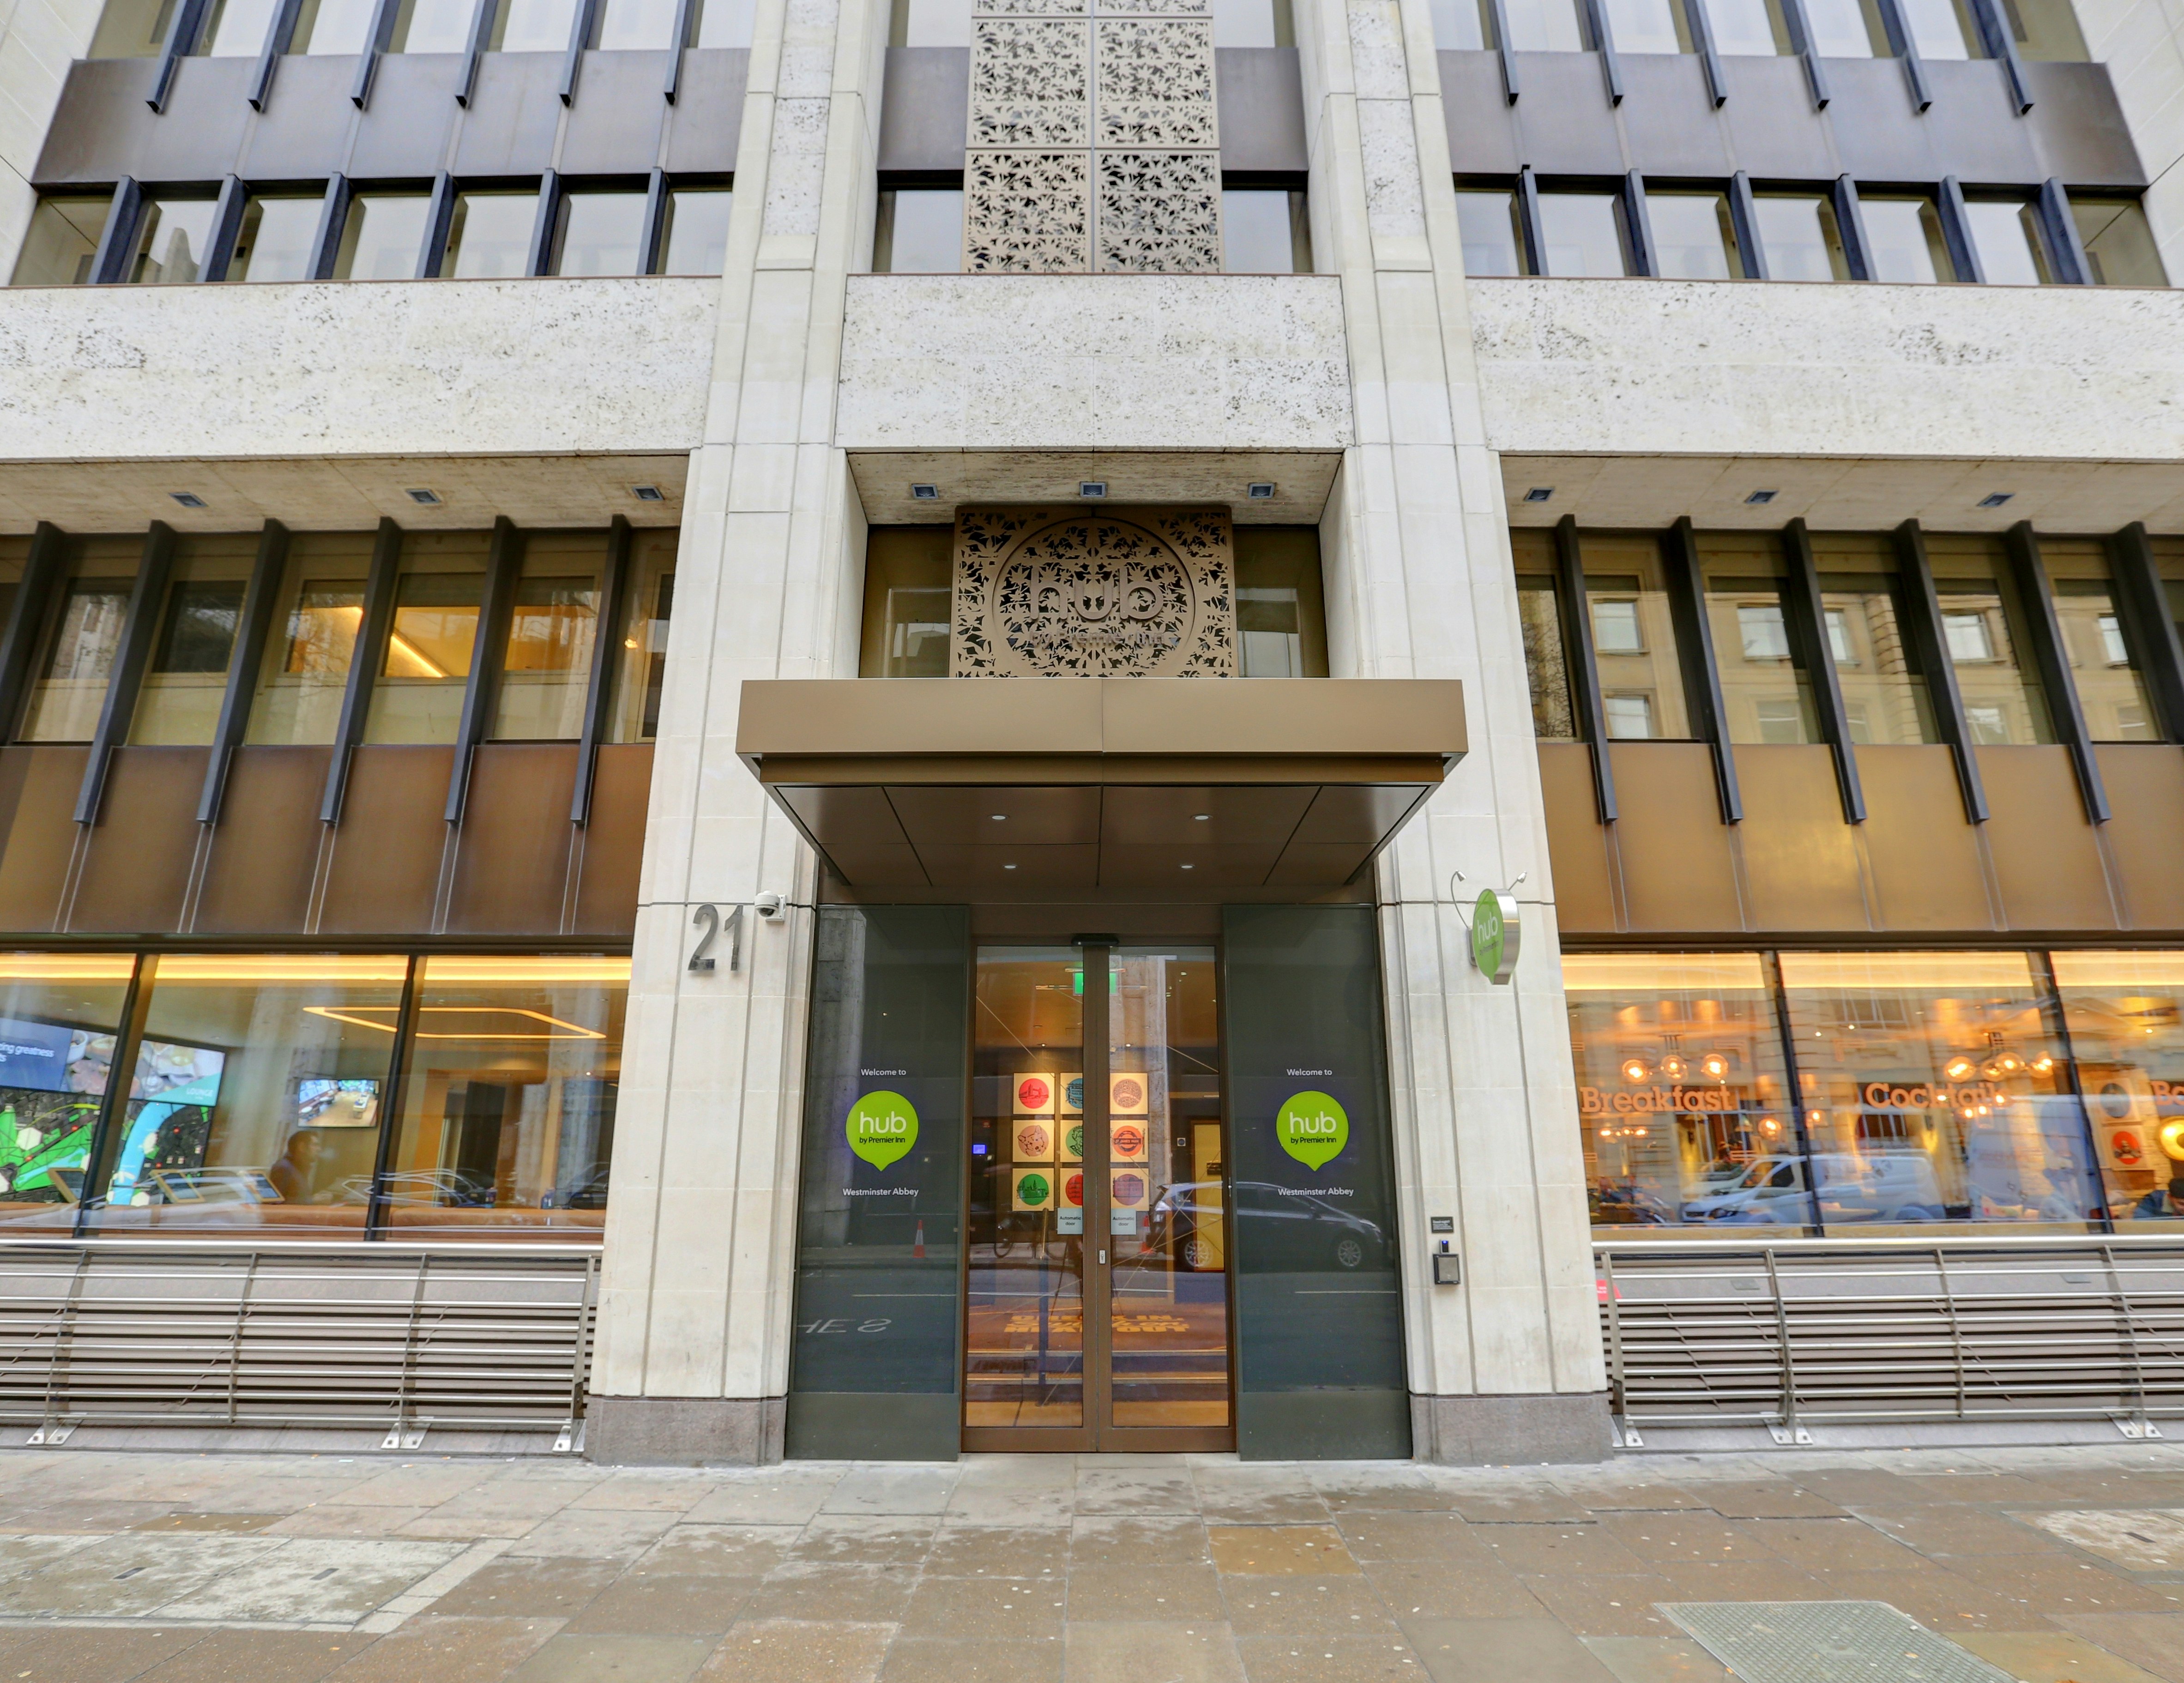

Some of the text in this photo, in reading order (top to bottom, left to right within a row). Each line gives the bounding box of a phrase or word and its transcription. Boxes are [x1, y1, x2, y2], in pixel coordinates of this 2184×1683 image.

[1030, 566, 1164, 620] hub
[1030, 628, 1165, 648] by Premier Inn
[688, 903, 744, 971] 21
[1477, 911, 1498, 944] hub
[1580, 1084, 1733, 1113] Breakfast
[859, 1110, 907, 1134] hub
[1289, 1110, 1337, 1134] hub
[859, 1136, 868, 1145] by
[1290, 1136, 1299, 1145] by
[843, 1188, 919, 1197] Westminster Abbey
[1278, 1187, 1354, 1197] Westminster Abbey
